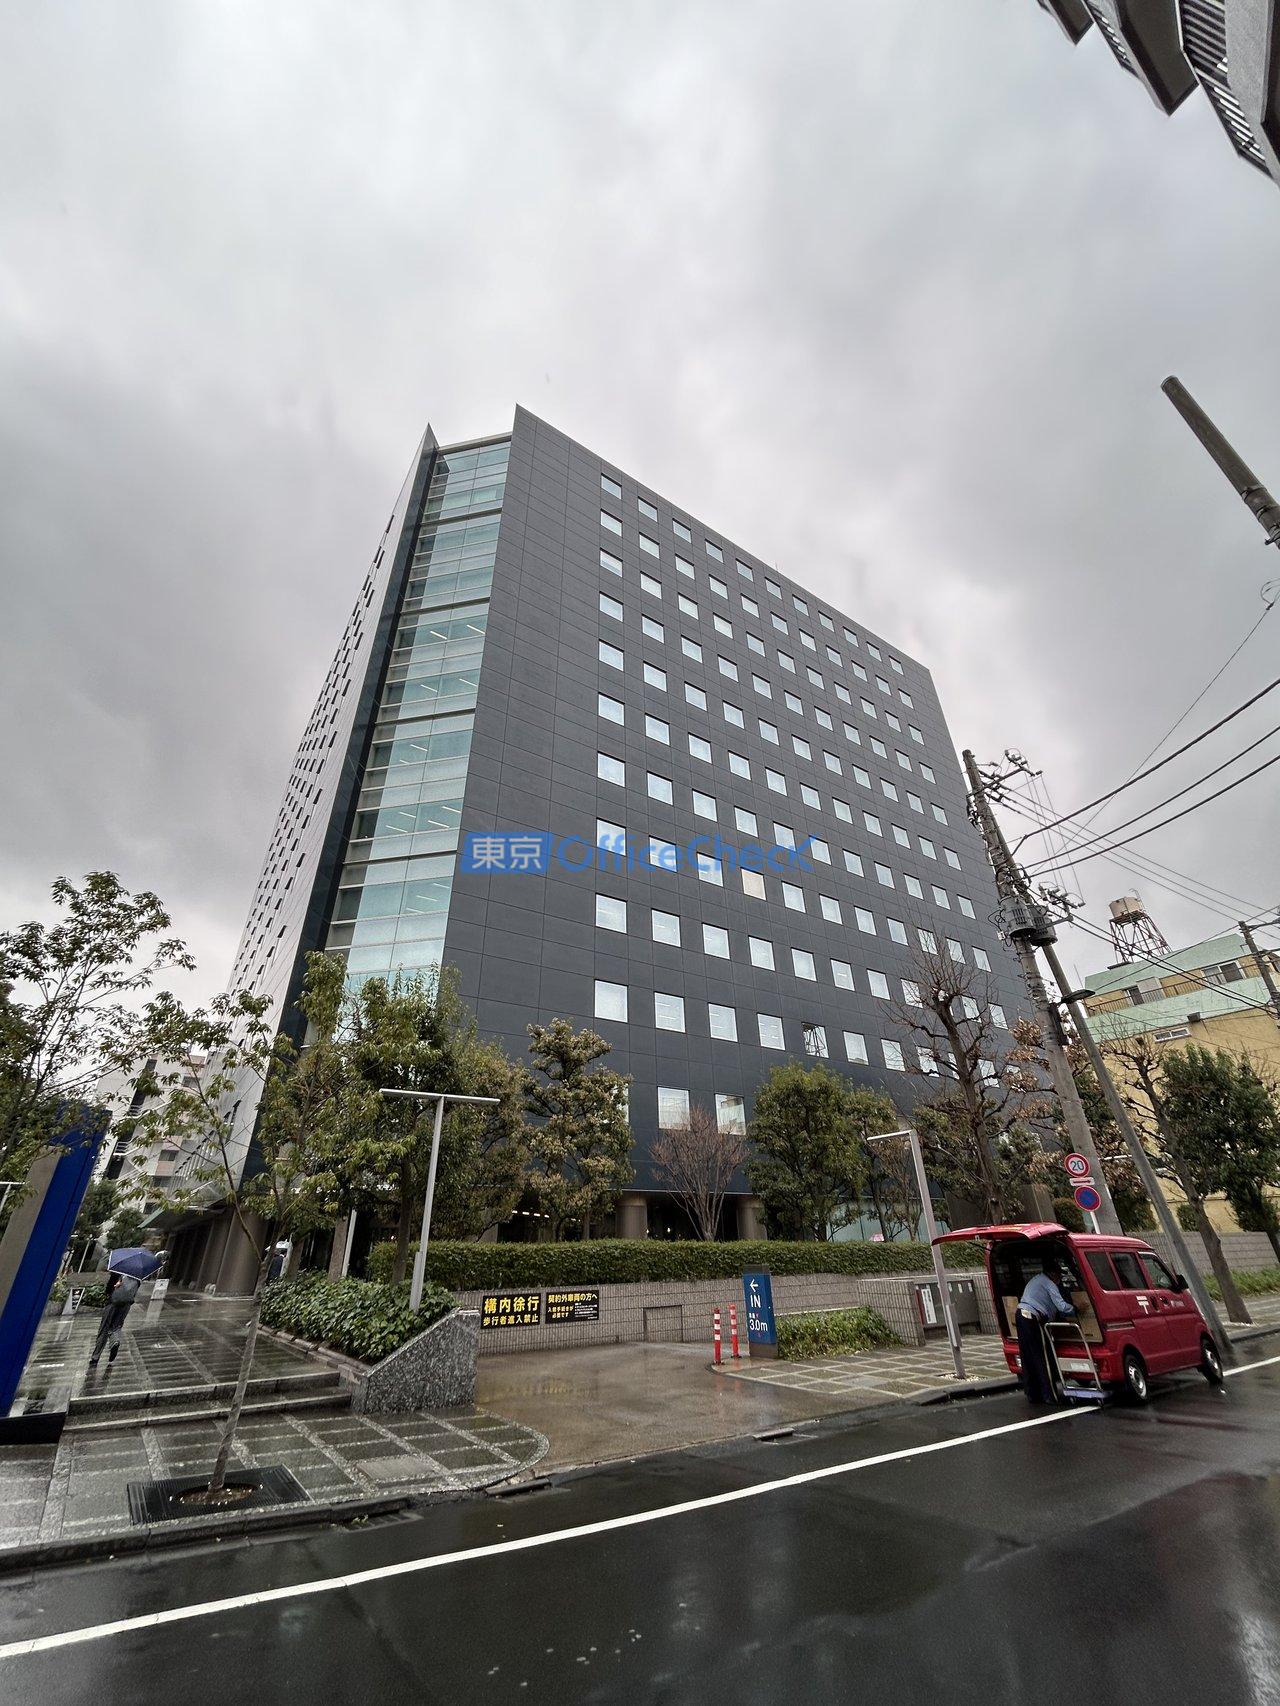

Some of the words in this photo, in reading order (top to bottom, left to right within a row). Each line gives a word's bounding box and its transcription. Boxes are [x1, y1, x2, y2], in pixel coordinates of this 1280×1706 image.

[1070, 1160, 1084, 1171] 20
[484, 1296, 539, 1314] 構内徐行
[750, 1295, 761, 1307] IN
[483, 1314, 539, 1326] 歩行者進入禁止
